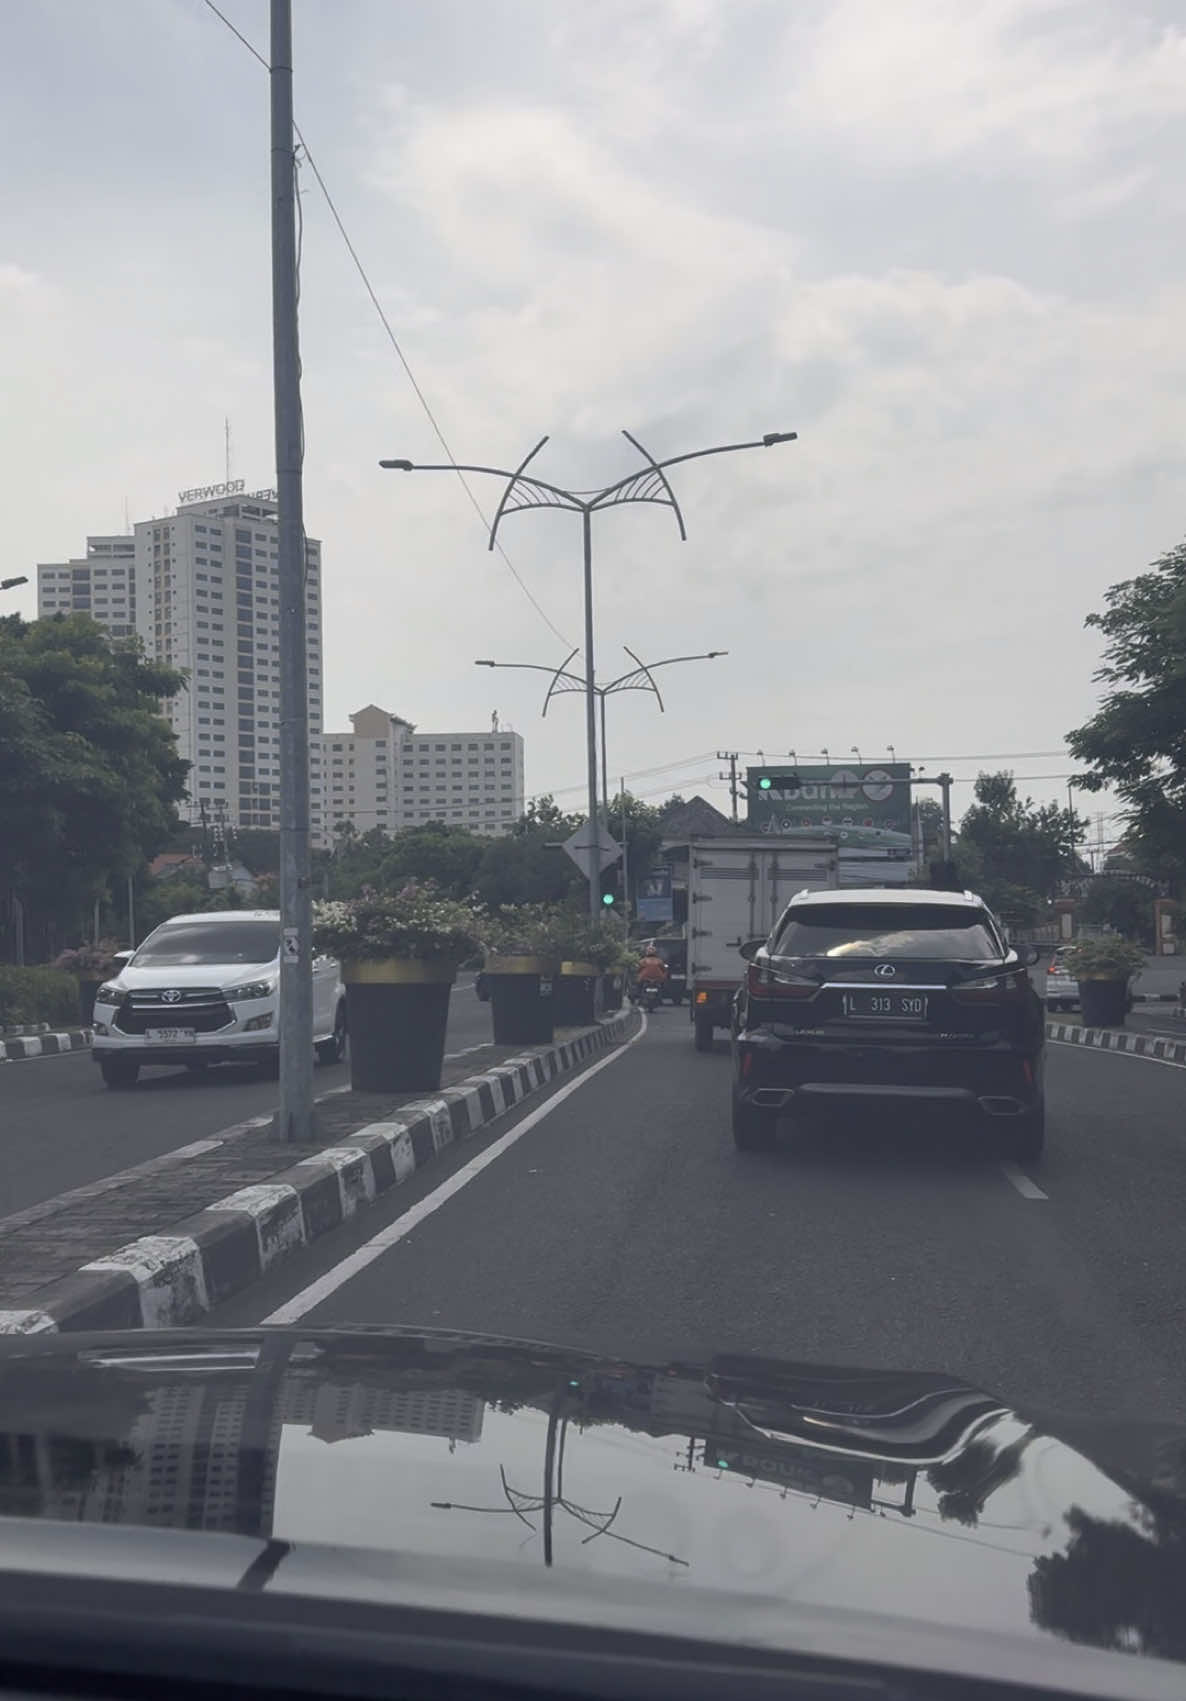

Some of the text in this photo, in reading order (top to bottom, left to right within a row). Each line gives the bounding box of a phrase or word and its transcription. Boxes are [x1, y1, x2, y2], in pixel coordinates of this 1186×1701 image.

[178, 479, 245, 503] VERWOOD
[849, 996, 856, 1011] L
[871, 997, 891, 1012] 313
